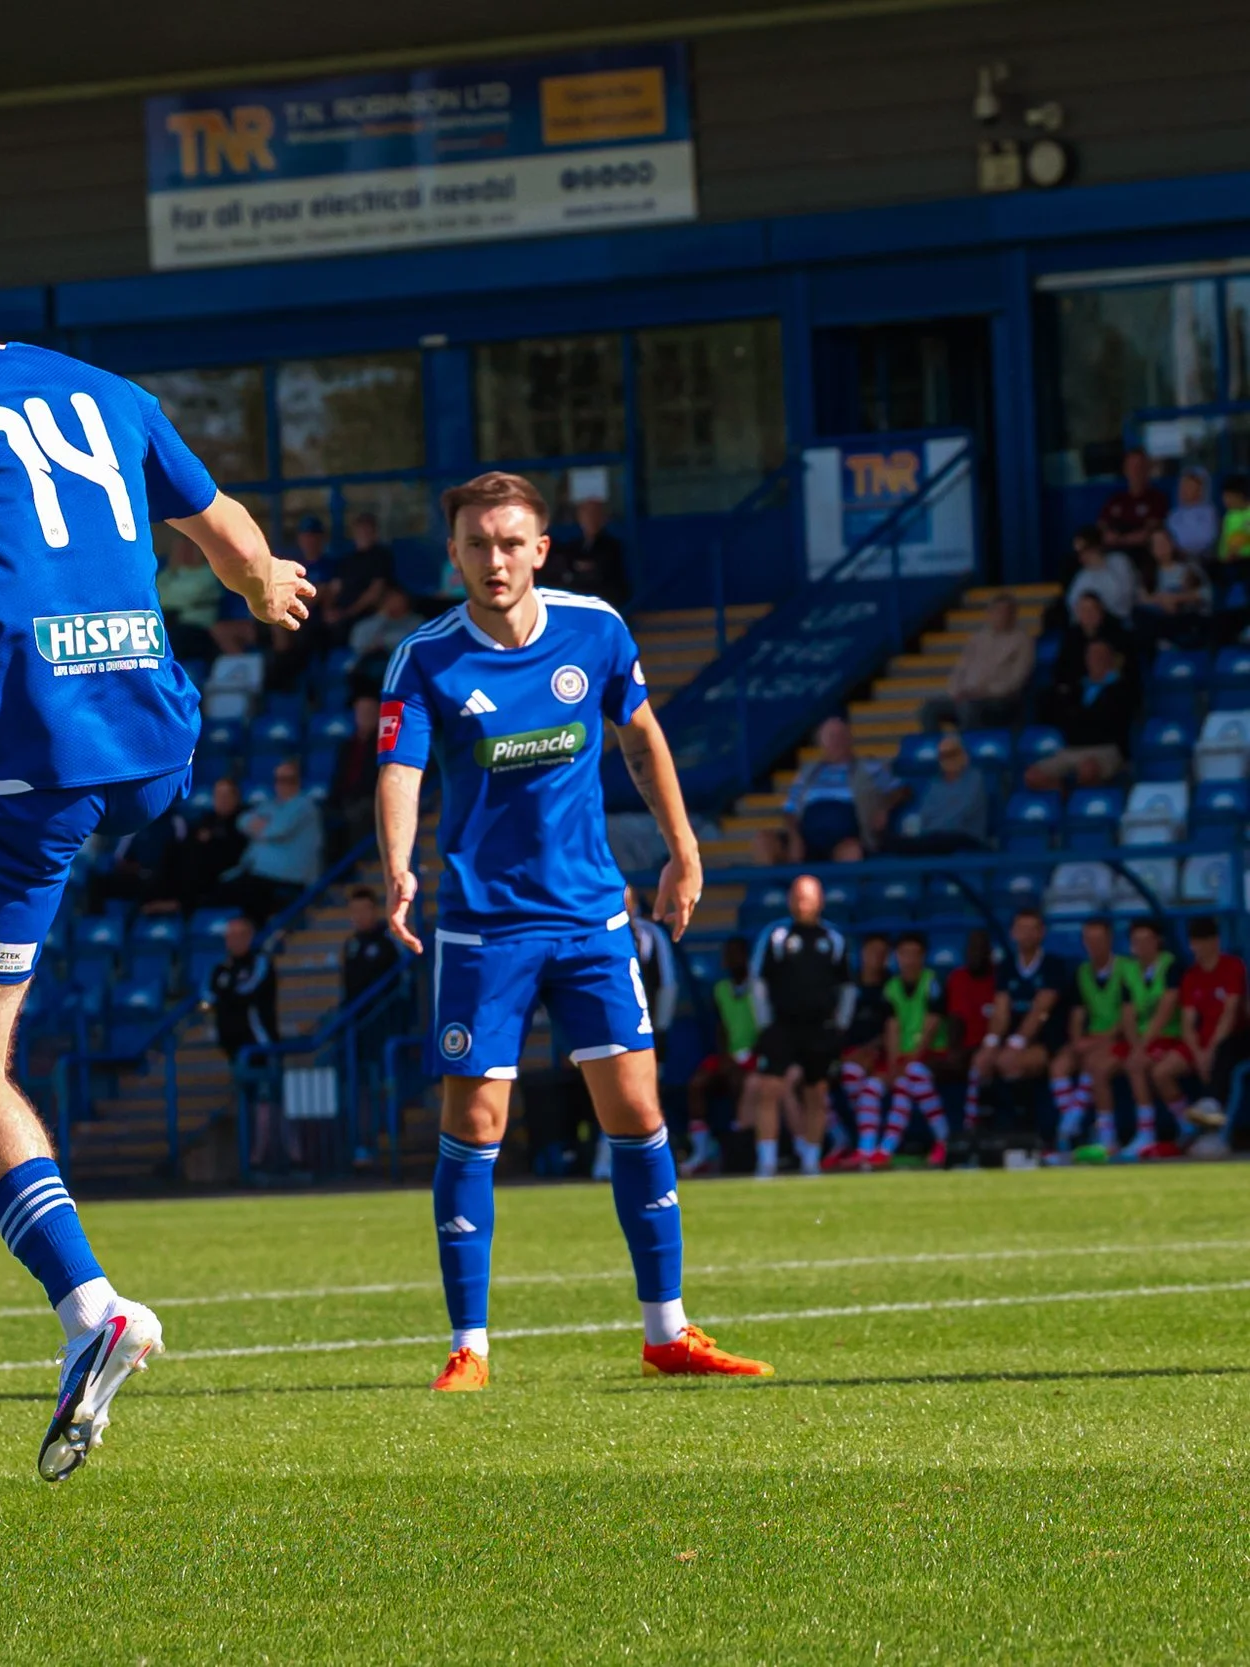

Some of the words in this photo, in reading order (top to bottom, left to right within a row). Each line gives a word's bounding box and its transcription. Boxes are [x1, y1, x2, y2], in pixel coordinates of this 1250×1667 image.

[167, 105, 277, 179] TNR
[169, 203, 207, 231] For
[213, 198, 241, 227] all
[249, 196, 303, 228] your
[309, 184, 423, 221] electrical
[492, 730, 576, 762] Pinnacle
